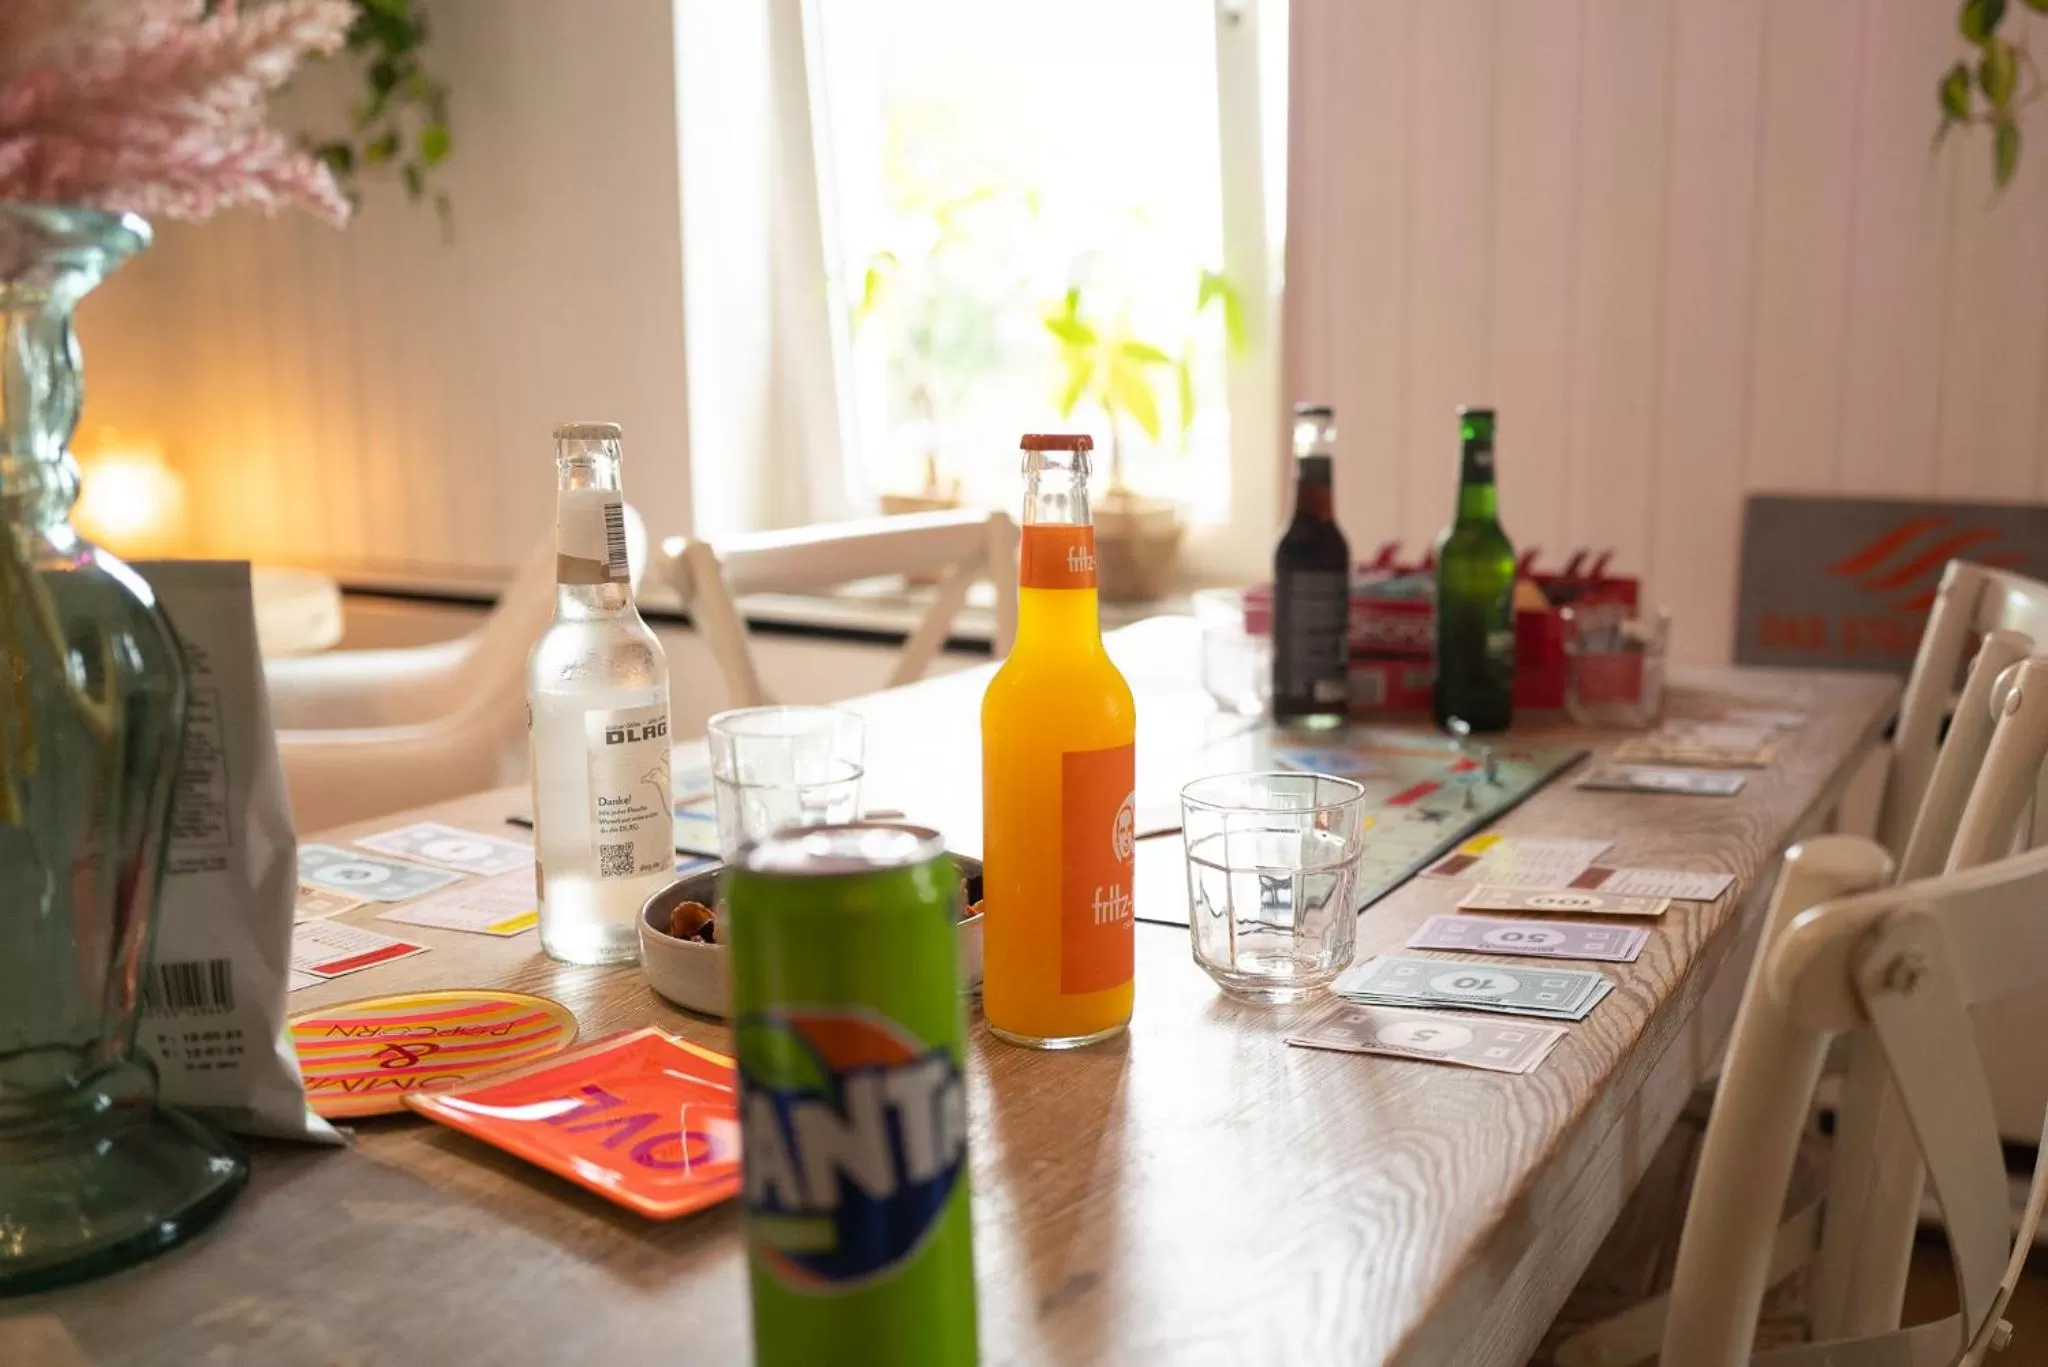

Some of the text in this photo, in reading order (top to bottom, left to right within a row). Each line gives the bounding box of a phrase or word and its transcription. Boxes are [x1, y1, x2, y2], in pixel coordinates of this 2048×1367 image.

[606, 721, 667, 745] DLRG
[598, 793, 632, 807] Danke!
[1532, 897, 1593, 907] 100
[1500, 932, 1550, 943] 50
[1452, 978, 1497, 991] 10
[326, 1021, 516, 1040] POPCORN
[1408, 1030, 1441, 1042] 5
[371, 1041, 441, 1069] &
